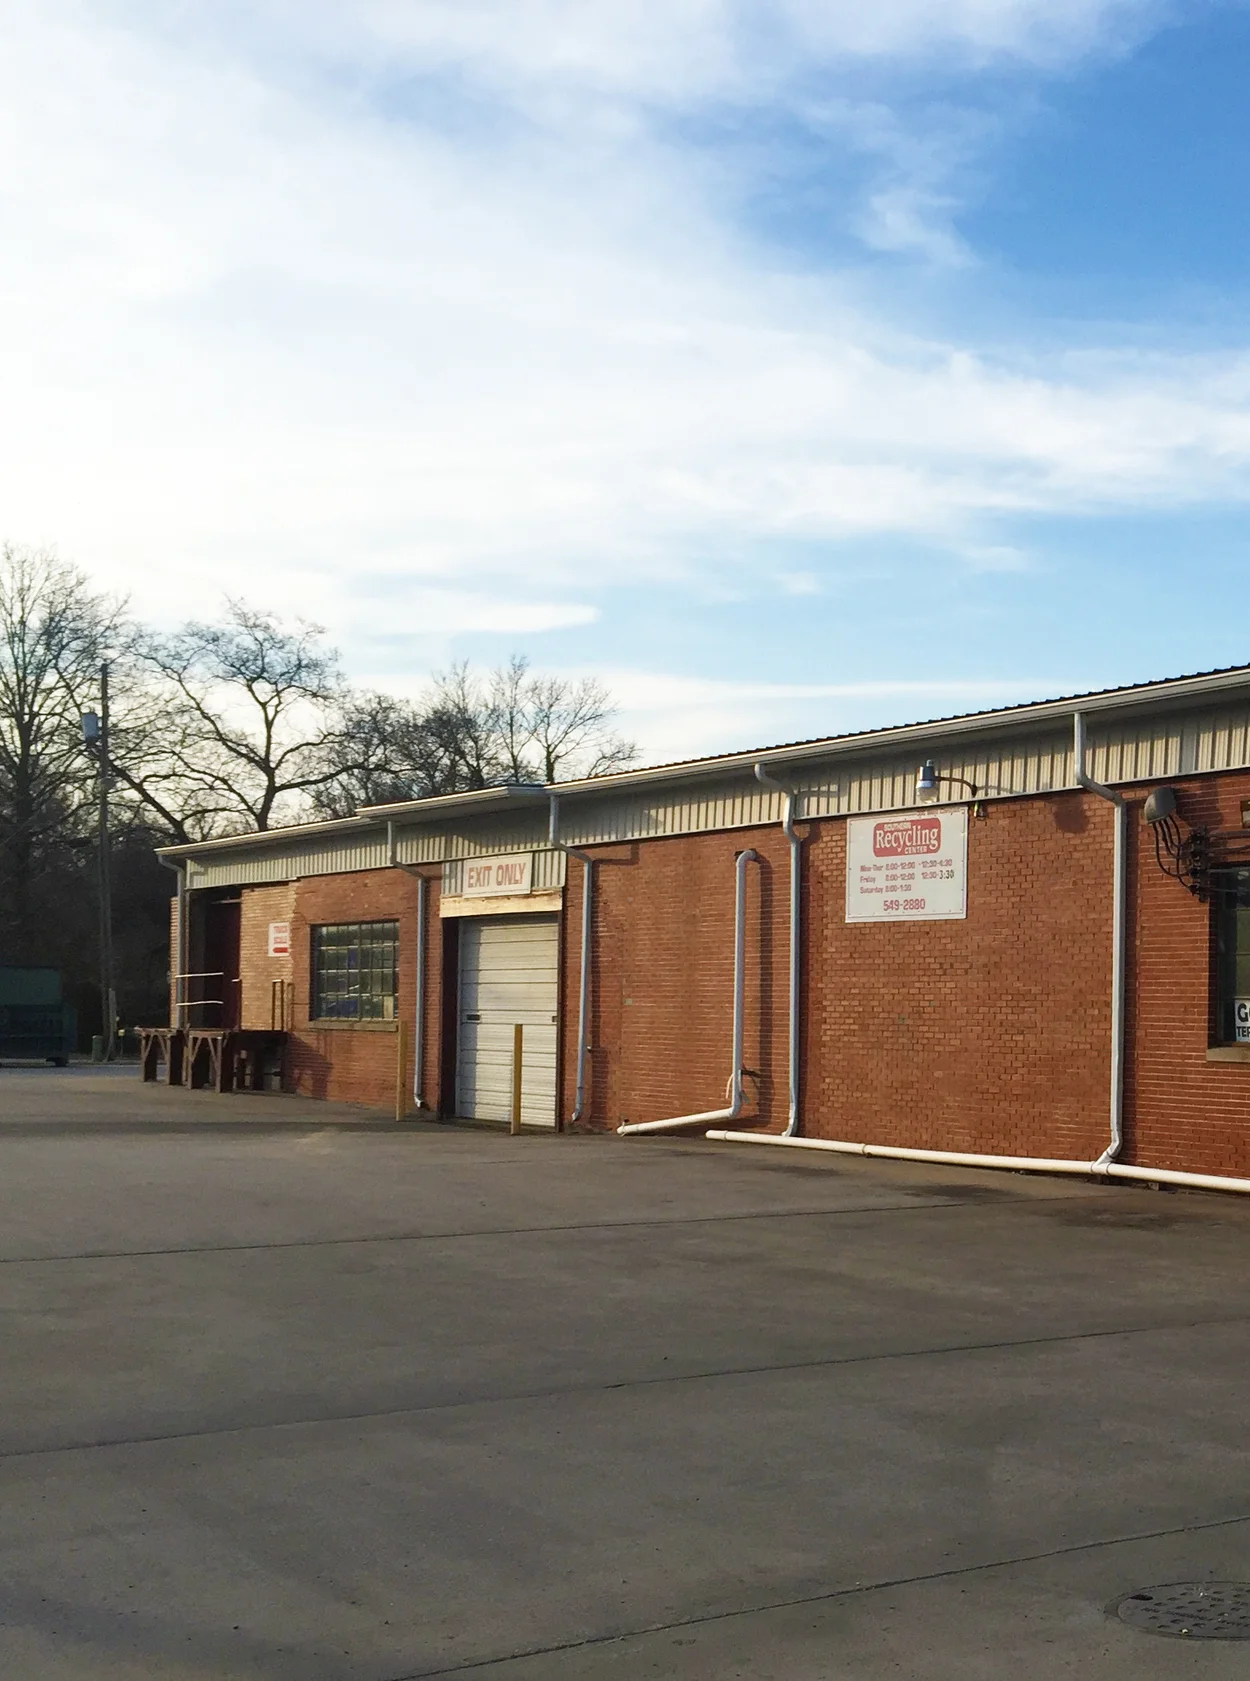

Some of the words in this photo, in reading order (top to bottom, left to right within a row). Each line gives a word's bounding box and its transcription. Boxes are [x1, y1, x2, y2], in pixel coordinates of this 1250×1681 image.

[875, 825, 939, 853] Recycling
[904, 845, 928, 855] CENTER
[468, 865, 492, 888] EXIT
[496, 862, 526, 886] ONLY
[883, 898, 926, 911] 549-2880
